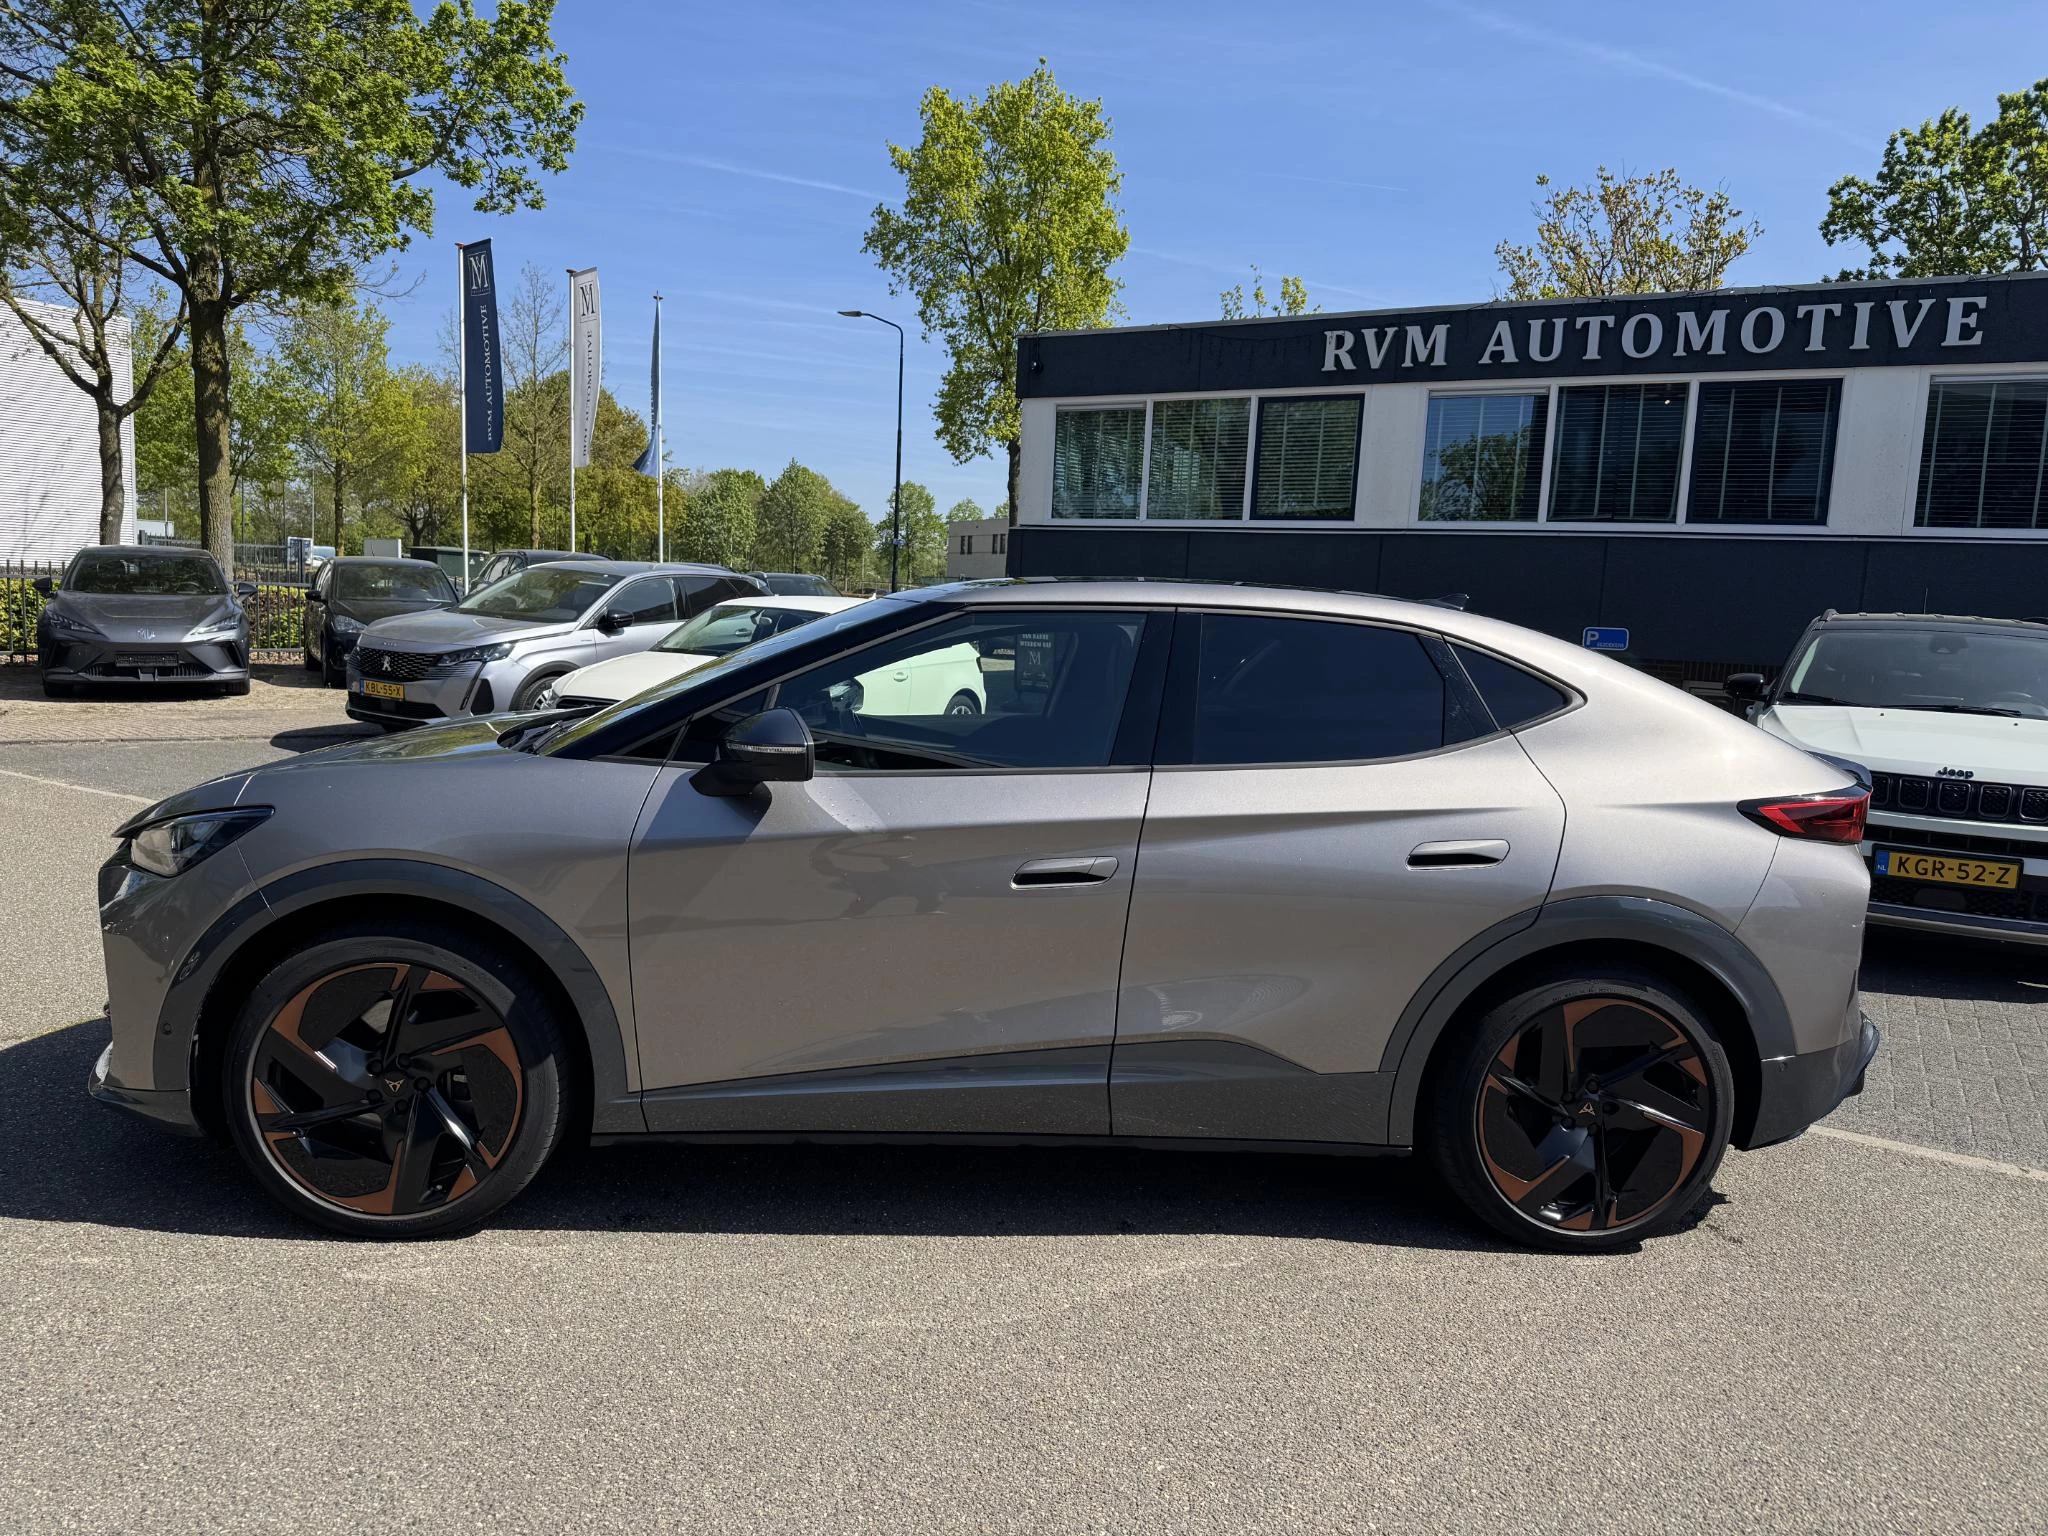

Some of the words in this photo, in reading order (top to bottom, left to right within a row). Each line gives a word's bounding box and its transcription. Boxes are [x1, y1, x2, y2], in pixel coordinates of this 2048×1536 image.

[1321, 323, 1451, 371] RVM
[1478, 296, 1988, 363] AUTOMOTIVE
[480, 304, 493, 405] AUTOMOTIVE
[365, 682, 401, 696] KBL-55-X
[1937, 766, 1974, 780] Jeep
[1897, 856, 2011, 884] KGR-52-Z
